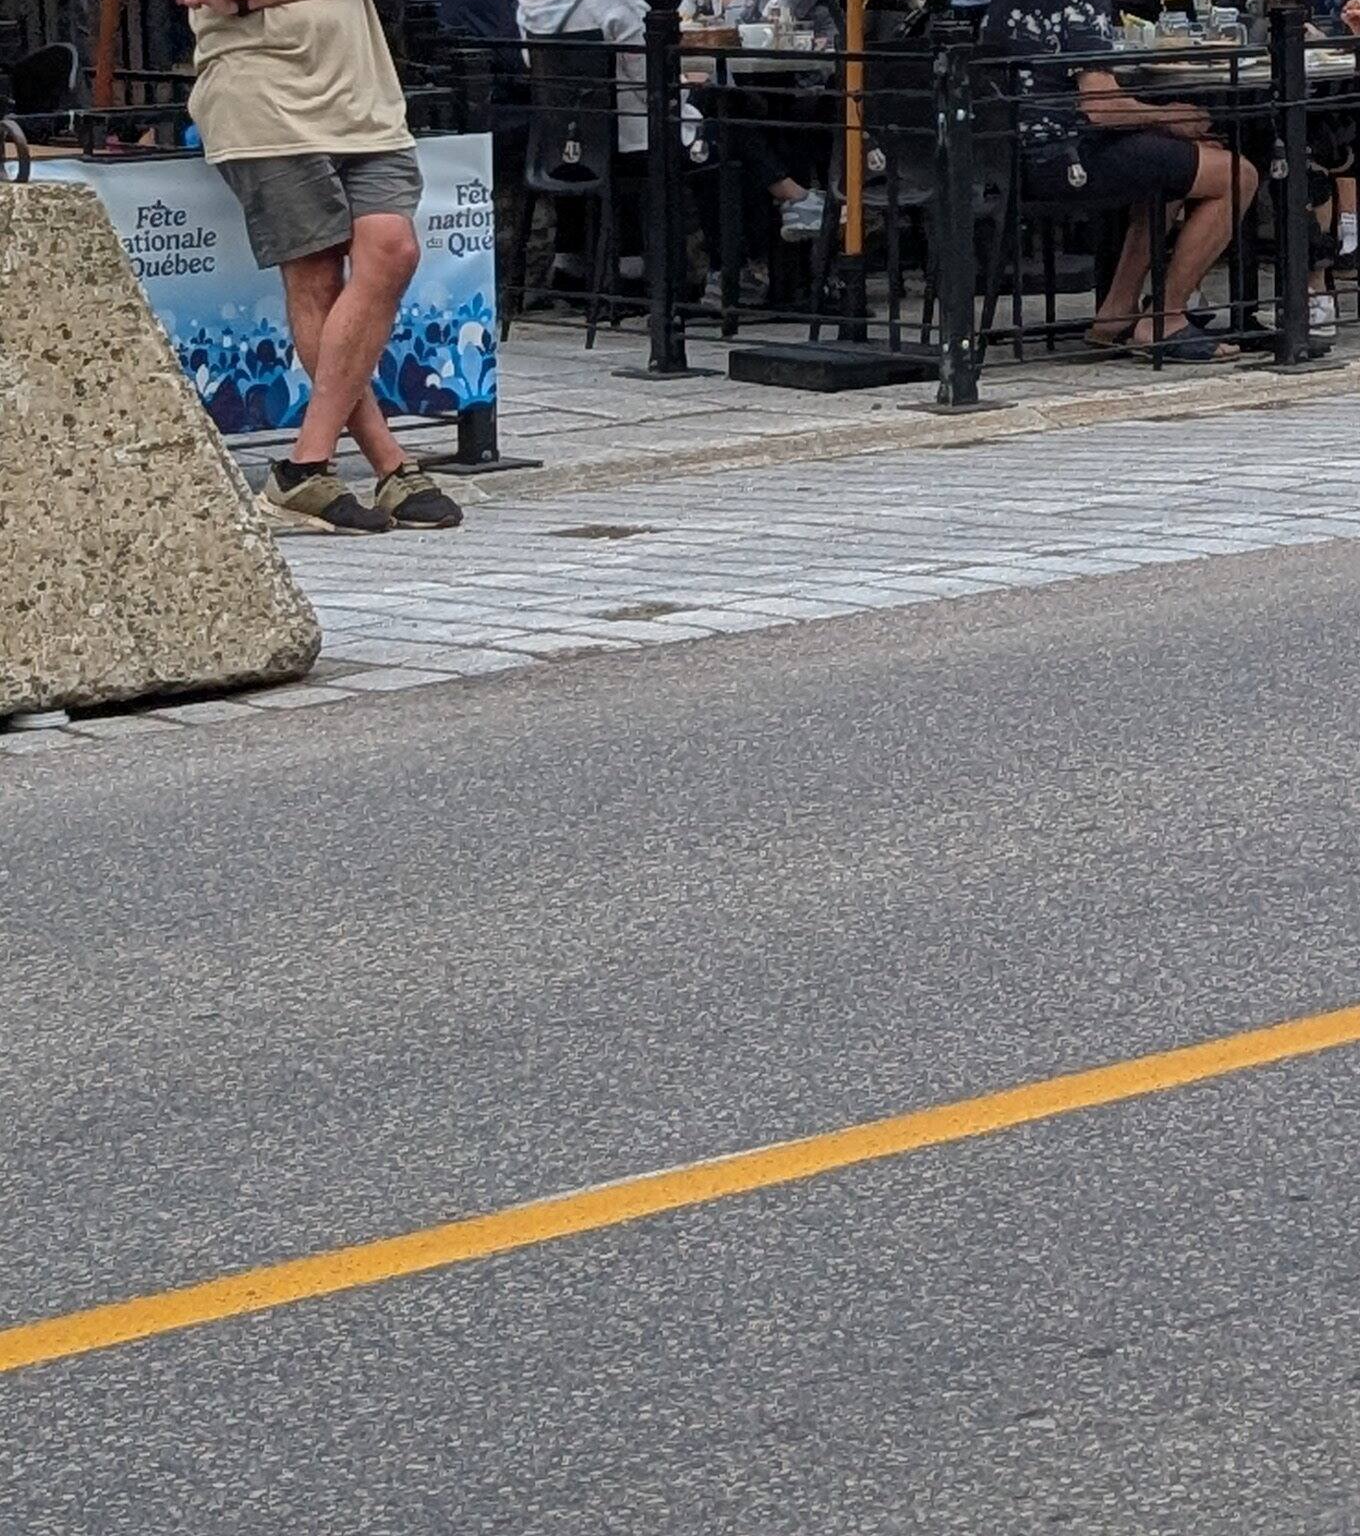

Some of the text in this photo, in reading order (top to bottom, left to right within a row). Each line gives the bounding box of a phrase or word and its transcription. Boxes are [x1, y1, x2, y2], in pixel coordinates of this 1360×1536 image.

[136, 199, 187, 229] Fête
[121, 227, 217, 254] ationale
[448, 232, 494, 258] Qué
[130, 253, 216, 282] Québec
